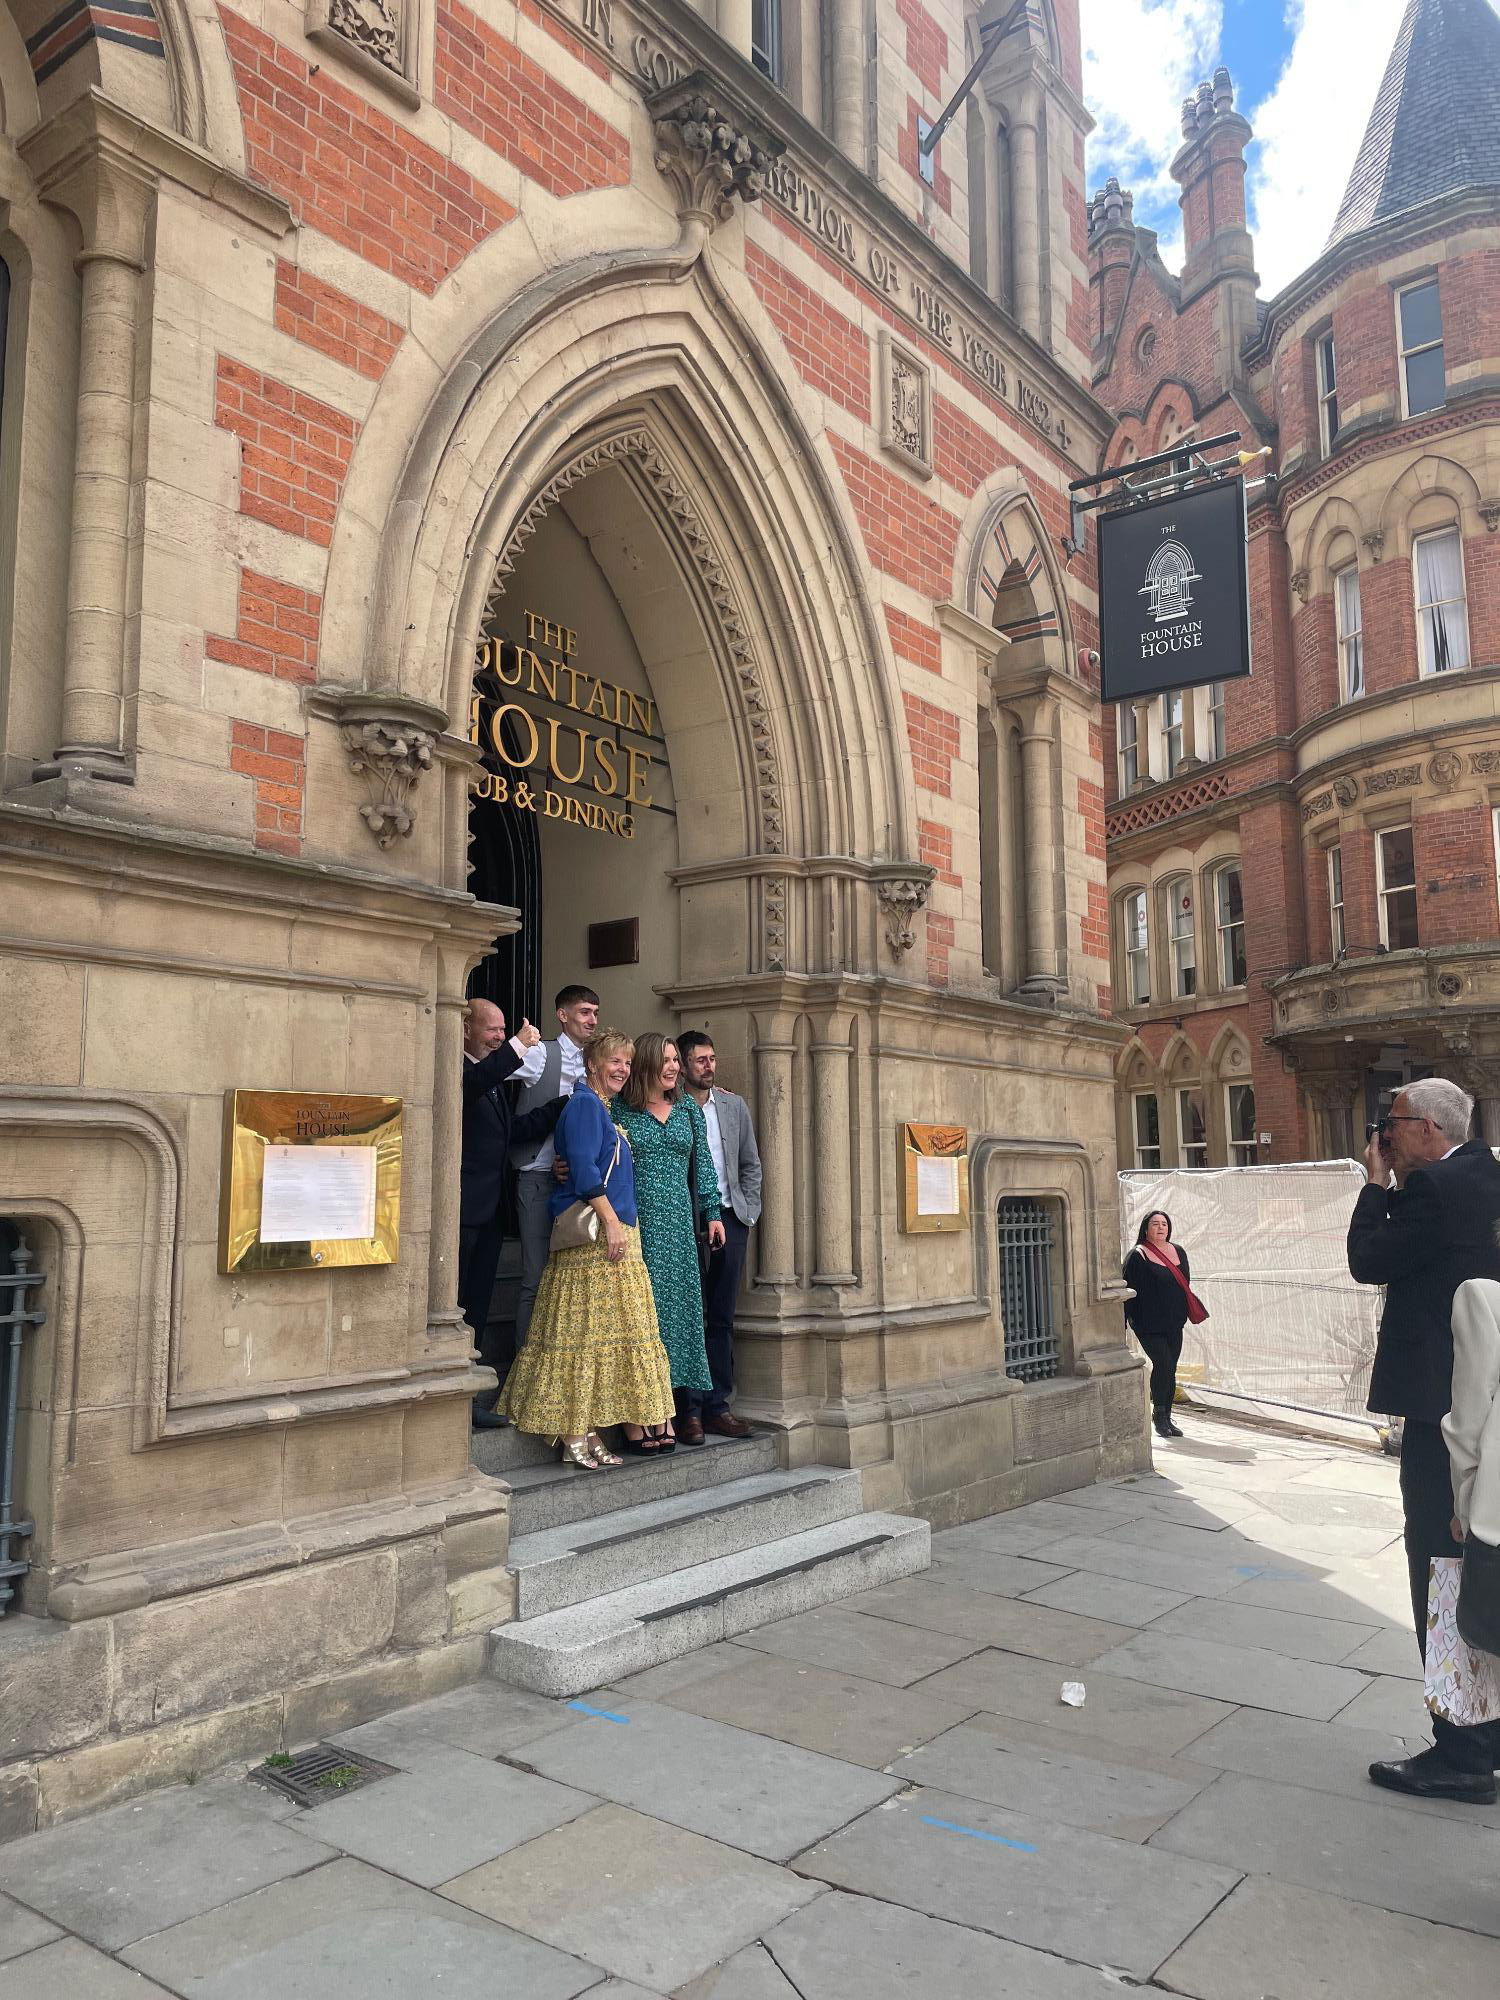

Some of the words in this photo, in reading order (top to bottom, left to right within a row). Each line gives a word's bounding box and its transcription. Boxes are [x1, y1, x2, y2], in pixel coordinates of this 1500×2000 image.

[911, 281, 953, 348] THE
[959, 326, 1007, 397] YEAR
[1161, 525, 1176, 534] THE
[524, 609, 578, 656] THE
[1141, 621, 1202, 643] FOUNTAIN
[1141, 633, 1203, 658] HOUSE
[480, 637, 655, 736] UNTAIN
[470, 695, 653, 807] OUSE
[476, 773, 508, 802] UB
[514, 781, 537, 811] &
[543, 790, 636, 840] DINING
[296, 1122, 350, 1136] HOUSE
